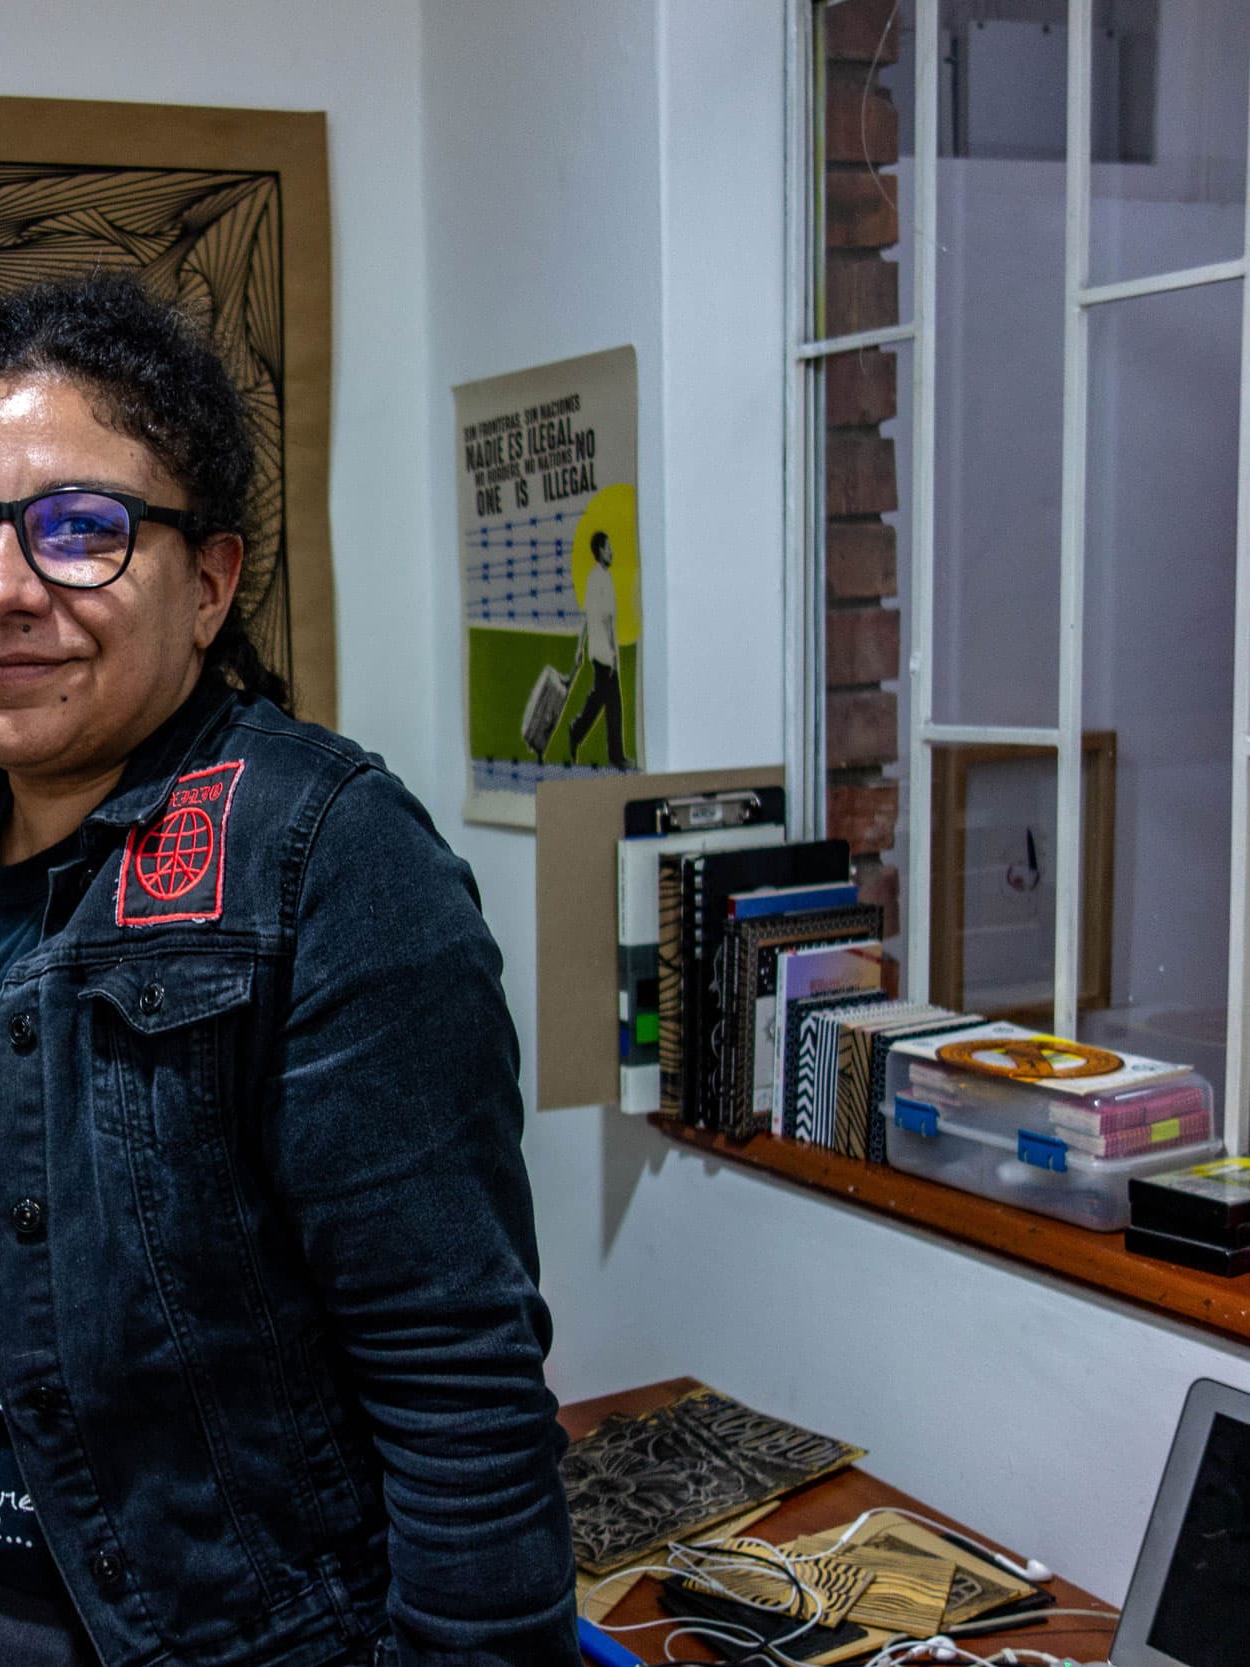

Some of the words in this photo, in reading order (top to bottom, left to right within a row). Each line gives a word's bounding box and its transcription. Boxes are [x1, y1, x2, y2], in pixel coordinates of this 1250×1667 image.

[464, 425, 477, 442] SIN
[479, 412, 521, 437] FRONTERAS
[524, 407, 538, 425] SIN
[540, 394, 581, 417] NACIONES
[465, 436, 504, 473] NADIE
[508, 430, 523, 461] ES
[528, 416, 574, 455] ILEGAL
[575, 428, 596, 462] NO
[475, 471, 485, 487] NO
[524, 458, 535, 475] NO
[538, 448, 572, 471] NATIONS
[476, 486, 502, 517] ONE
[515, 478, 529, 509] IS
[543, 461, 597, 503] ILLEGAL
